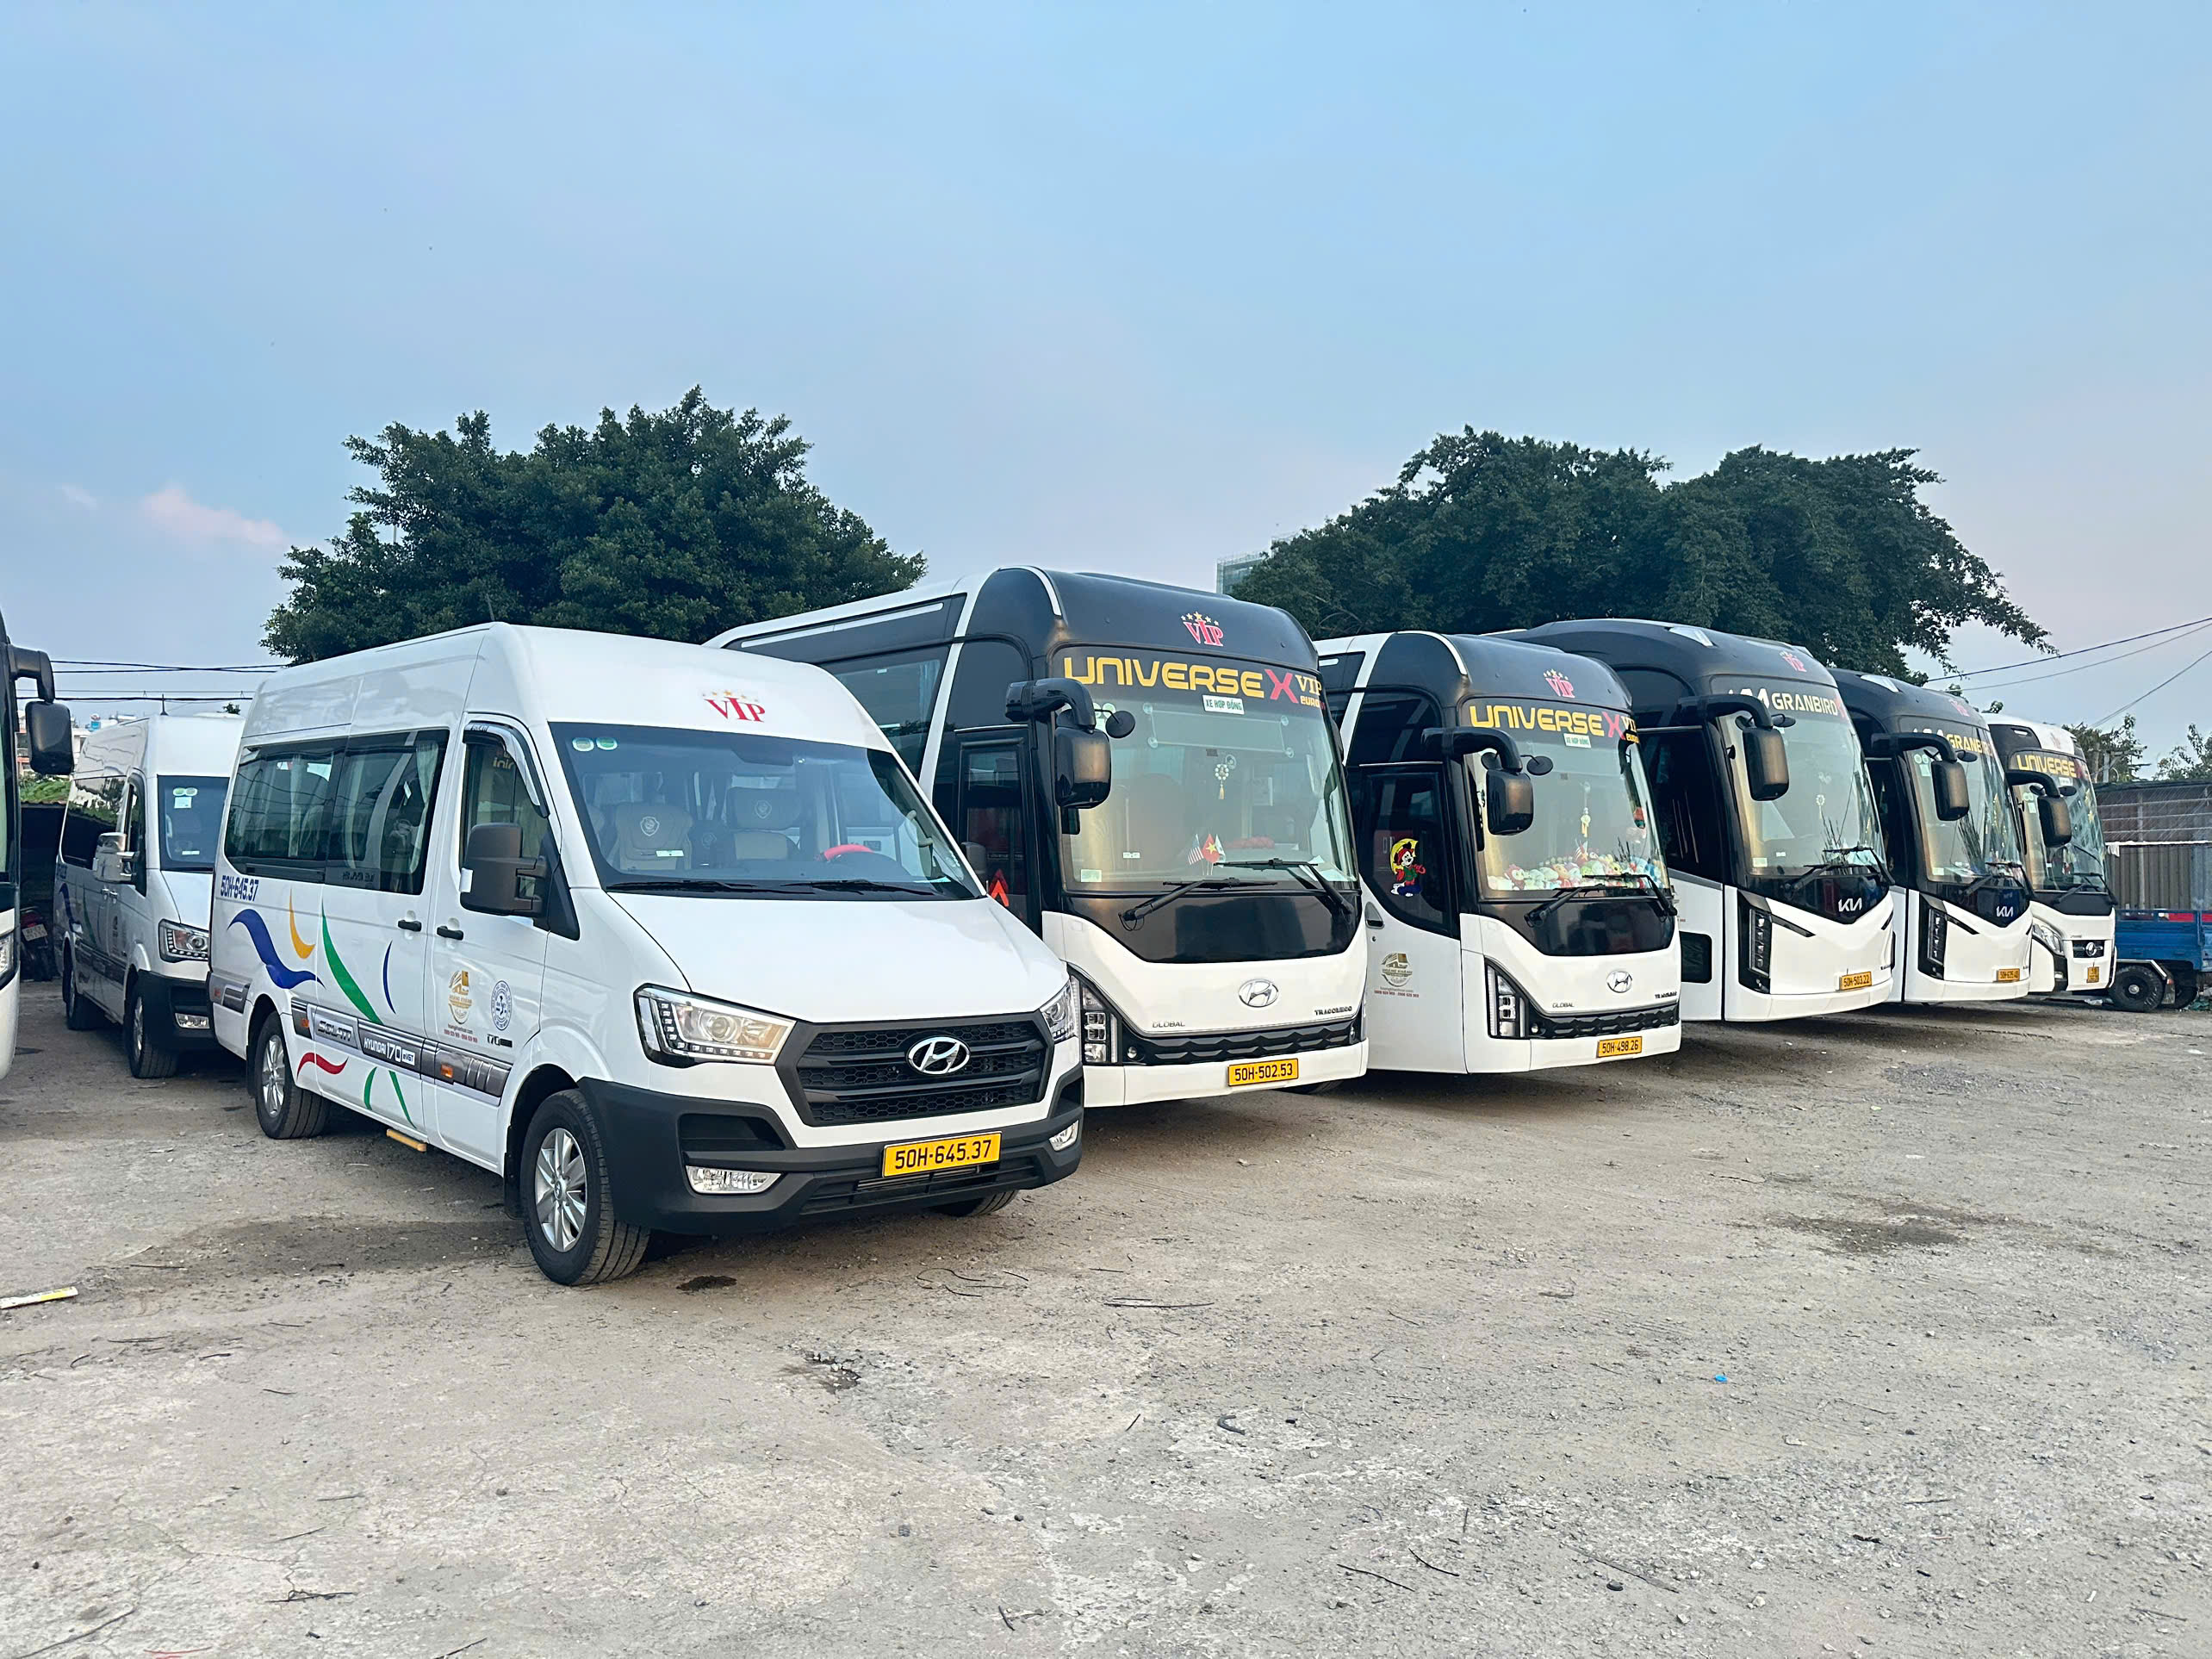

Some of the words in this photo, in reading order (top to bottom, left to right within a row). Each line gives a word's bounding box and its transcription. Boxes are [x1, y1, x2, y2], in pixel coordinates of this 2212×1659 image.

[1183, 619, 1223, 647] VIP
[1063, 656, 1264, 699] UNIVERSE
[1264, 668, 1299, 704] X
[1295, 674, 1322, 696] VIP
[1545, 674, 1575, 699] VIP
[704, 697, 766, 723] VIP
[1771, 693, 1838, 717] GRANBIRD
[1469, 705, 1605, 736] UNIVERSE
[1601, 711, 1625, 741] X
[2016, 754, 2078, 779] UNIVERSE
[220, 874, 258, 902] 50H-645.37
[1838, 898, 1862, 912] KIA
[1996, 905, 2014, 917] KIA
[318, 1020, 351, 1041] SOLATI
[363, 1037, 387, 1055] HYUNDAI
[386, 1042, 402, 1063] 170
[1602, 1040, 1639, 1053] 50H-498.26
[1234, 1063, 1293, 1082] 50H-502.53
[895, 1140, 991, 1170] 50H-645.37
